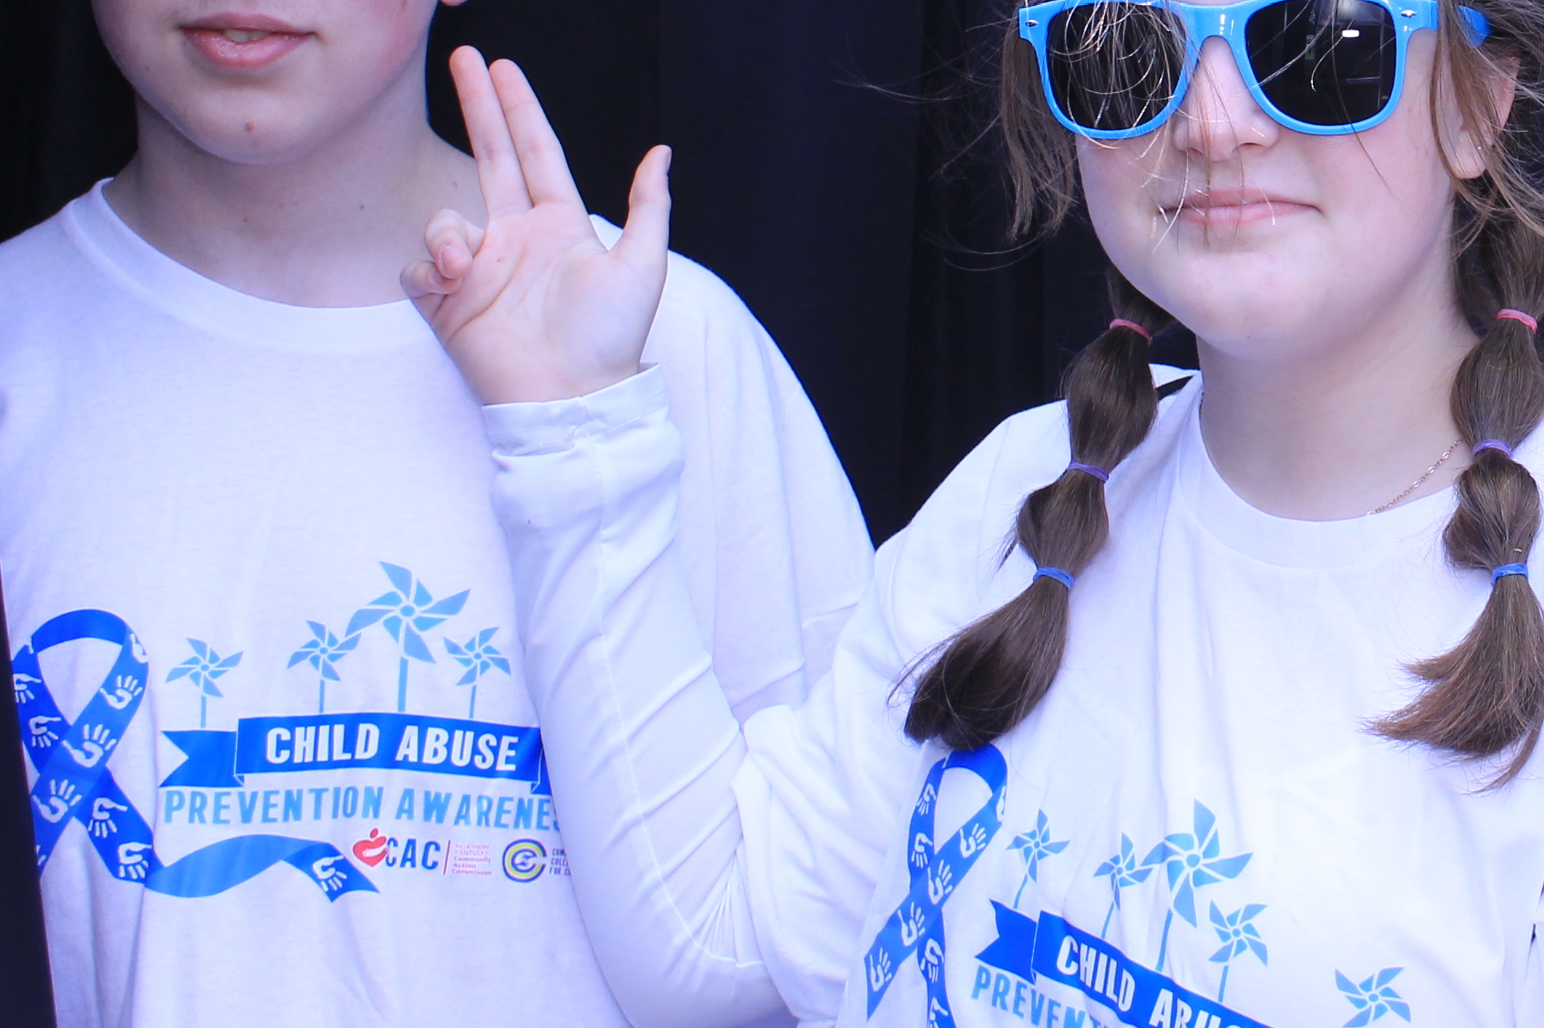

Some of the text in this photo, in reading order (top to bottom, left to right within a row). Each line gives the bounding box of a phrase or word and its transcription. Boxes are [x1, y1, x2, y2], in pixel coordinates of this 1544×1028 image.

[265, 723, 519, 771] CHILD ABUSE
[164, 785, 560, 833] PREVENTION AWARENE
[385, 836, 442, 870] CAC
[451, 868, 493, 876] Commission
[453, 856, 492, 864] Community
[970, 964, 1102, 1028] PREVEN
[1056, 934, 1136, 1012] CHILD
